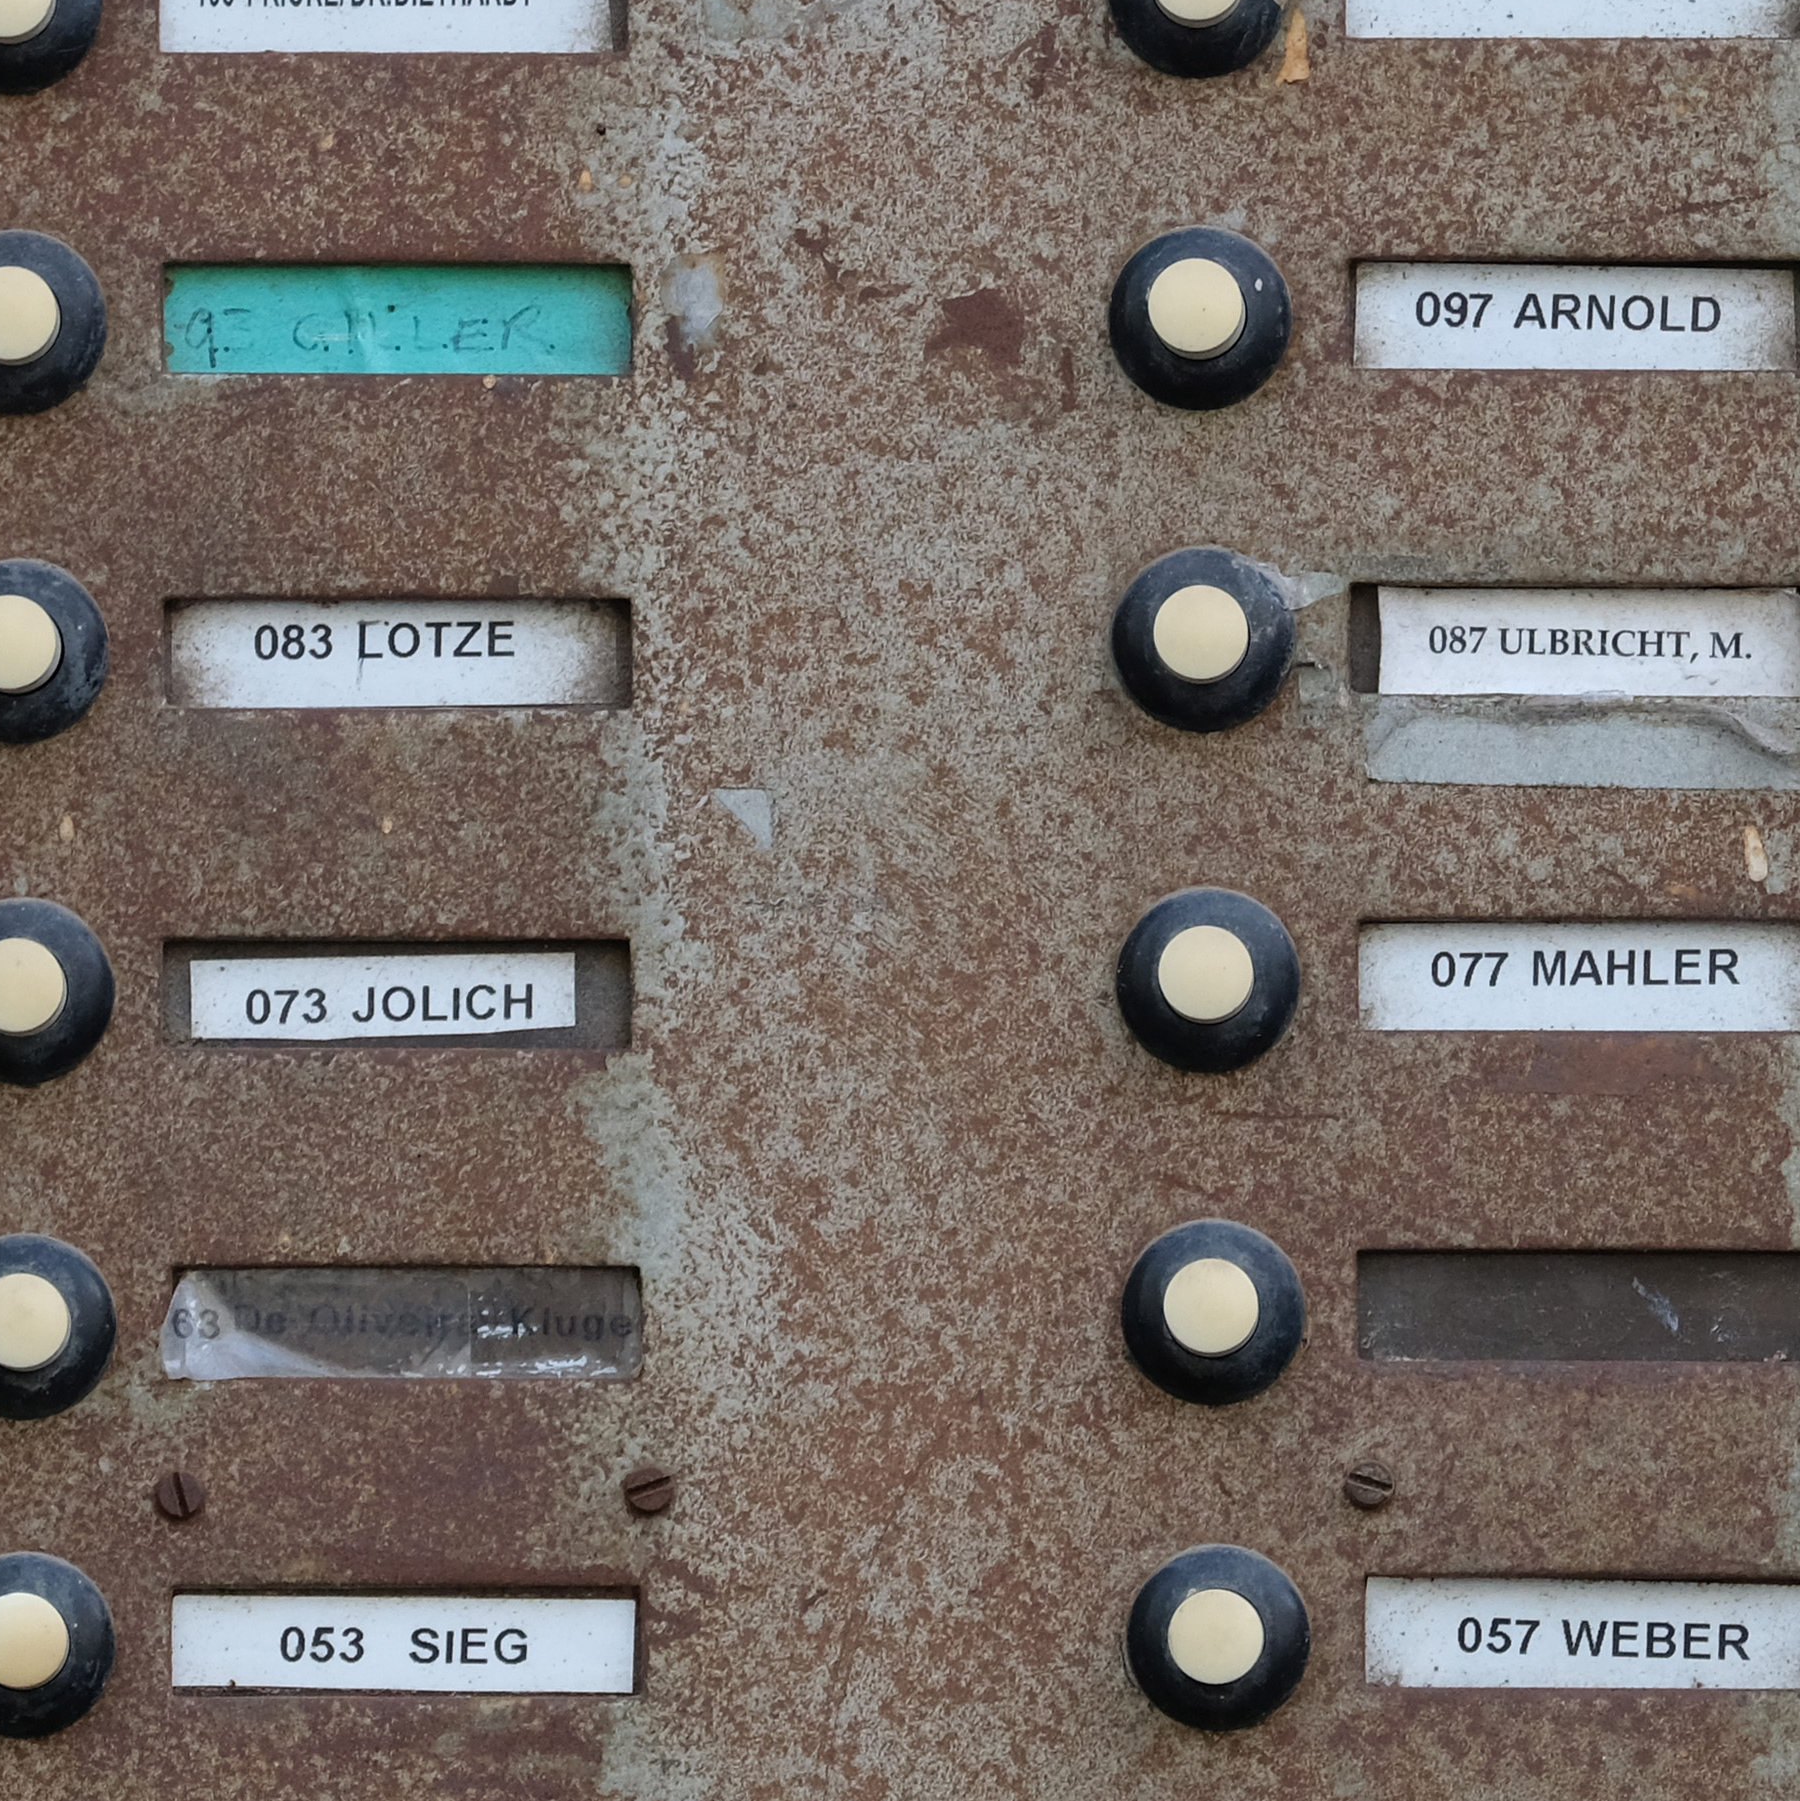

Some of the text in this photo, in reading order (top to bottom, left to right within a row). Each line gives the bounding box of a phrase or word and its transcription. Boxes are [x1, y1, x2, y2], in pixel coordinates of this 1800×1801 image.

[1415, 292, 1722, 333] 097 ARNOLD
[253, 620, 516, 661] 083 LOTZE
[1428, 626, 1752, 664] 087 ULBRICHT, M.
[1430, 948, 1740, 987] 077 MAHLER
[245, 983, 534, 1025] 073 JOLICH
[280, 1627, 529, 1664] 053 SIEG
[1457, 1618, 1750, 1660] 057 WEBER
